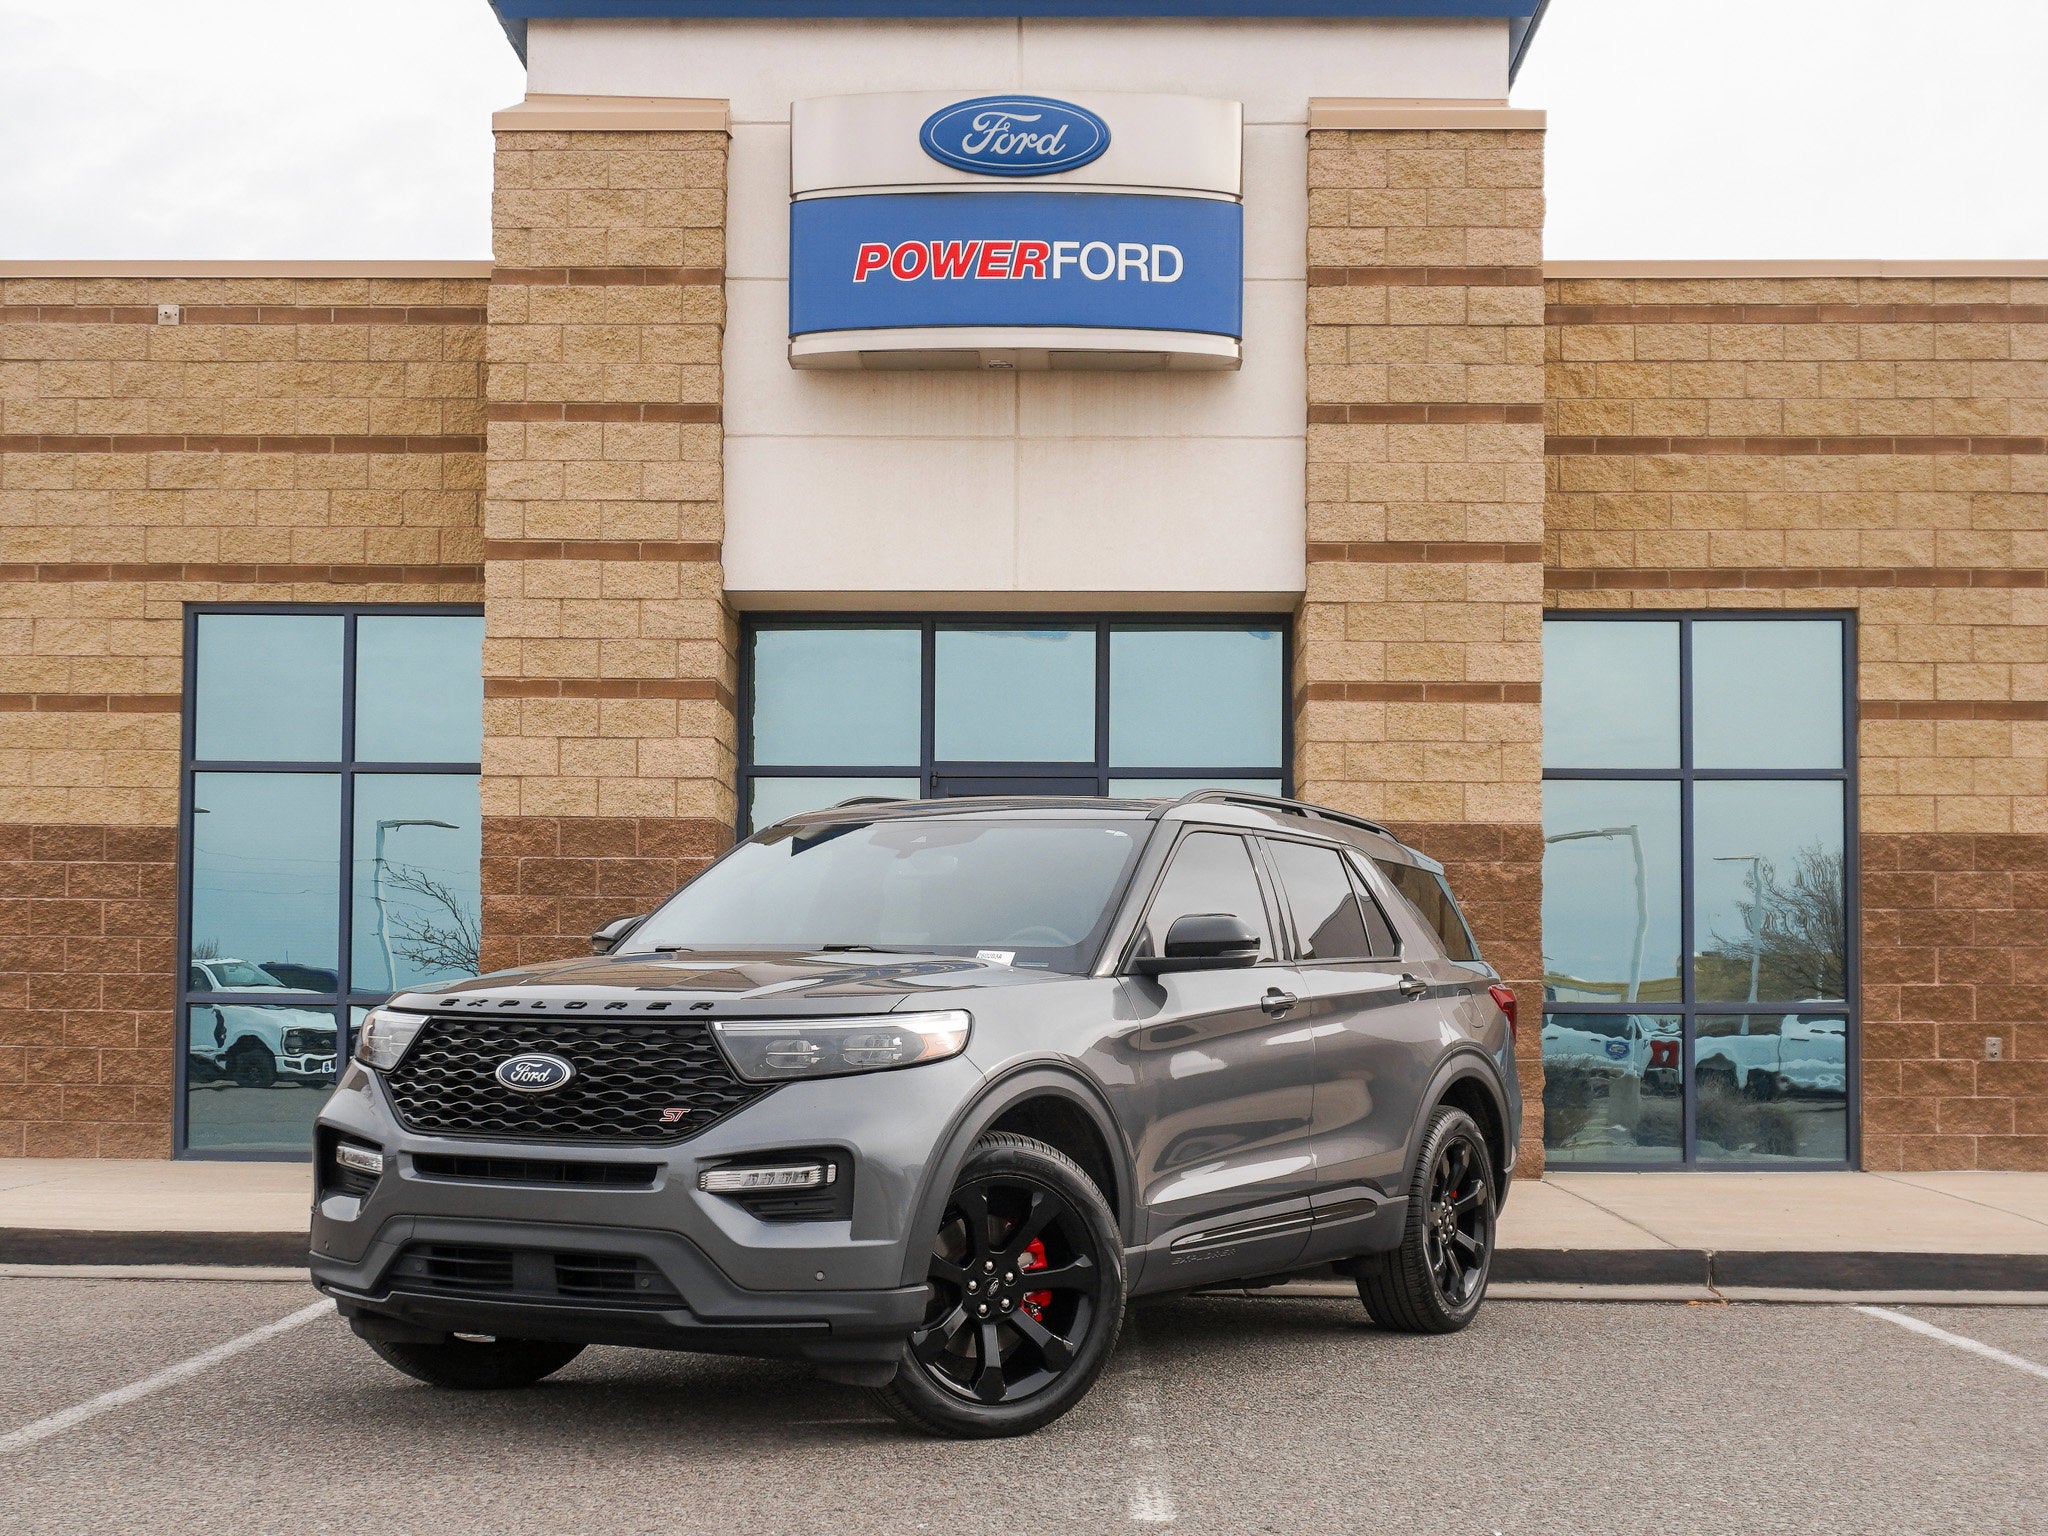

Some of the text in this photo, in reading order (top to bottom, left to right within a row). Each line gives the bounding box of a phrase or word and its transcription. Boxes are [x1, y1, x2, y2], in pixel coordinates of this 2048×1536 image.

[962, 111, 1068, 155] Ford
[439, 998, 715, 1011] EXPLORER
[510, 1062, 551, 1083] Ford
[659, 1107, 692, 1122] ST
